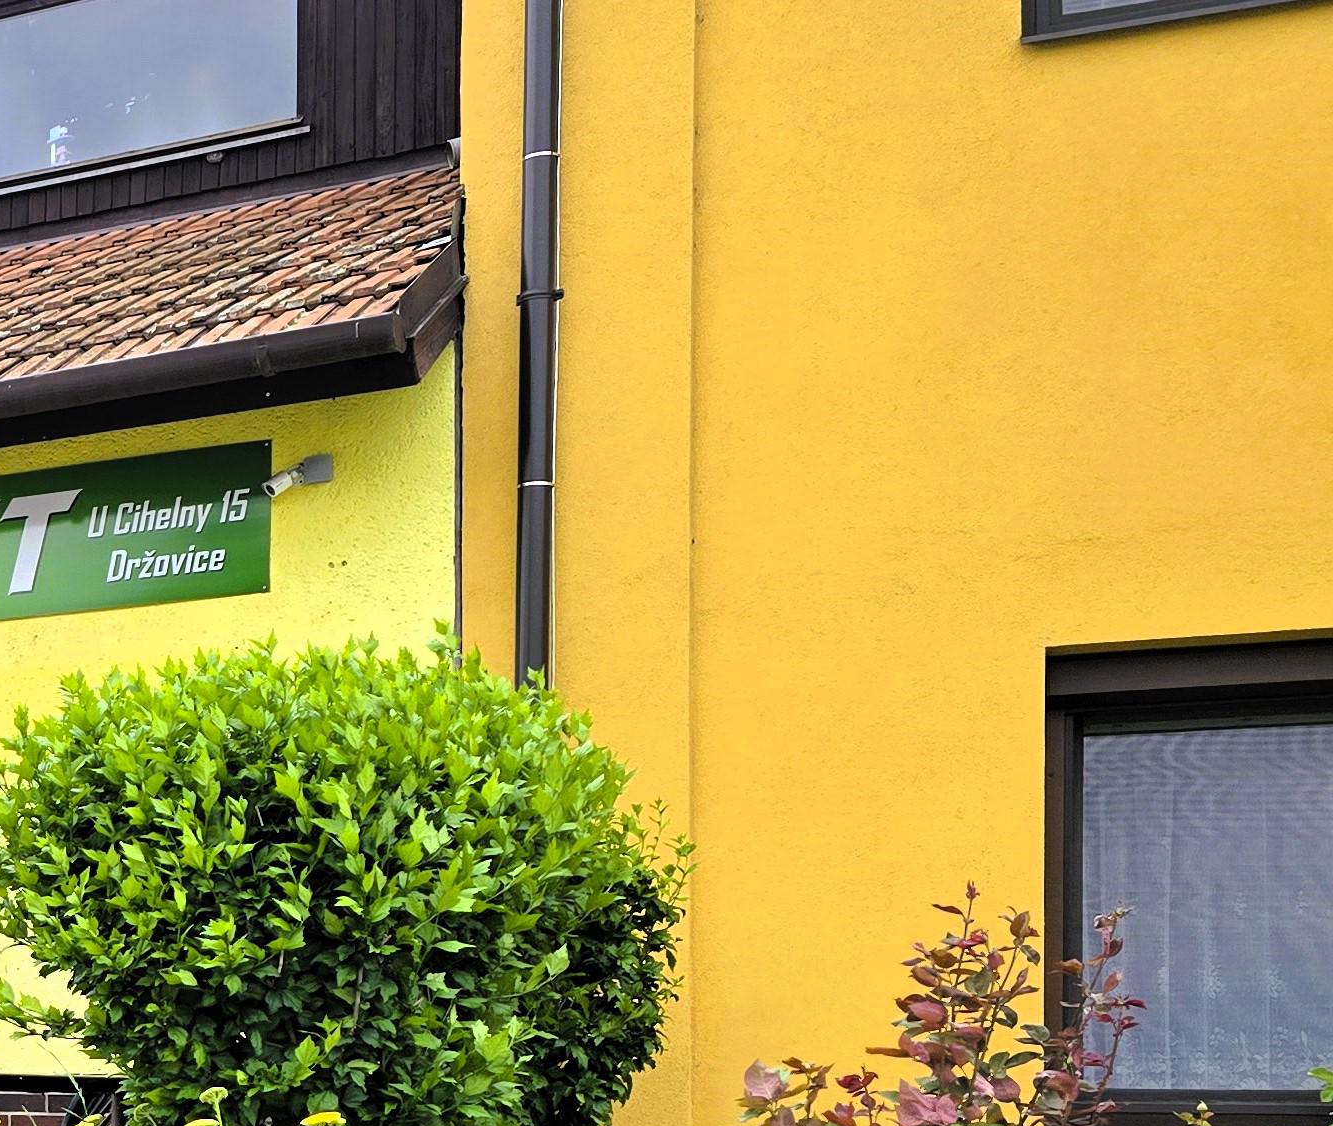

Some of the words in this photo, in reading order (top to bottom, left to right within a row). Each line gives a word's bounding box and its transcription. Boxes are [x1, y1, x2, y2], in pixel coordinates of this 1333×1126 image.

[87, 505, 109, 539] U
[113, 496, 213, 534] Cihelny
[219, 488, 251, 524] 15
[106, 545, 226, 583] Držovice
